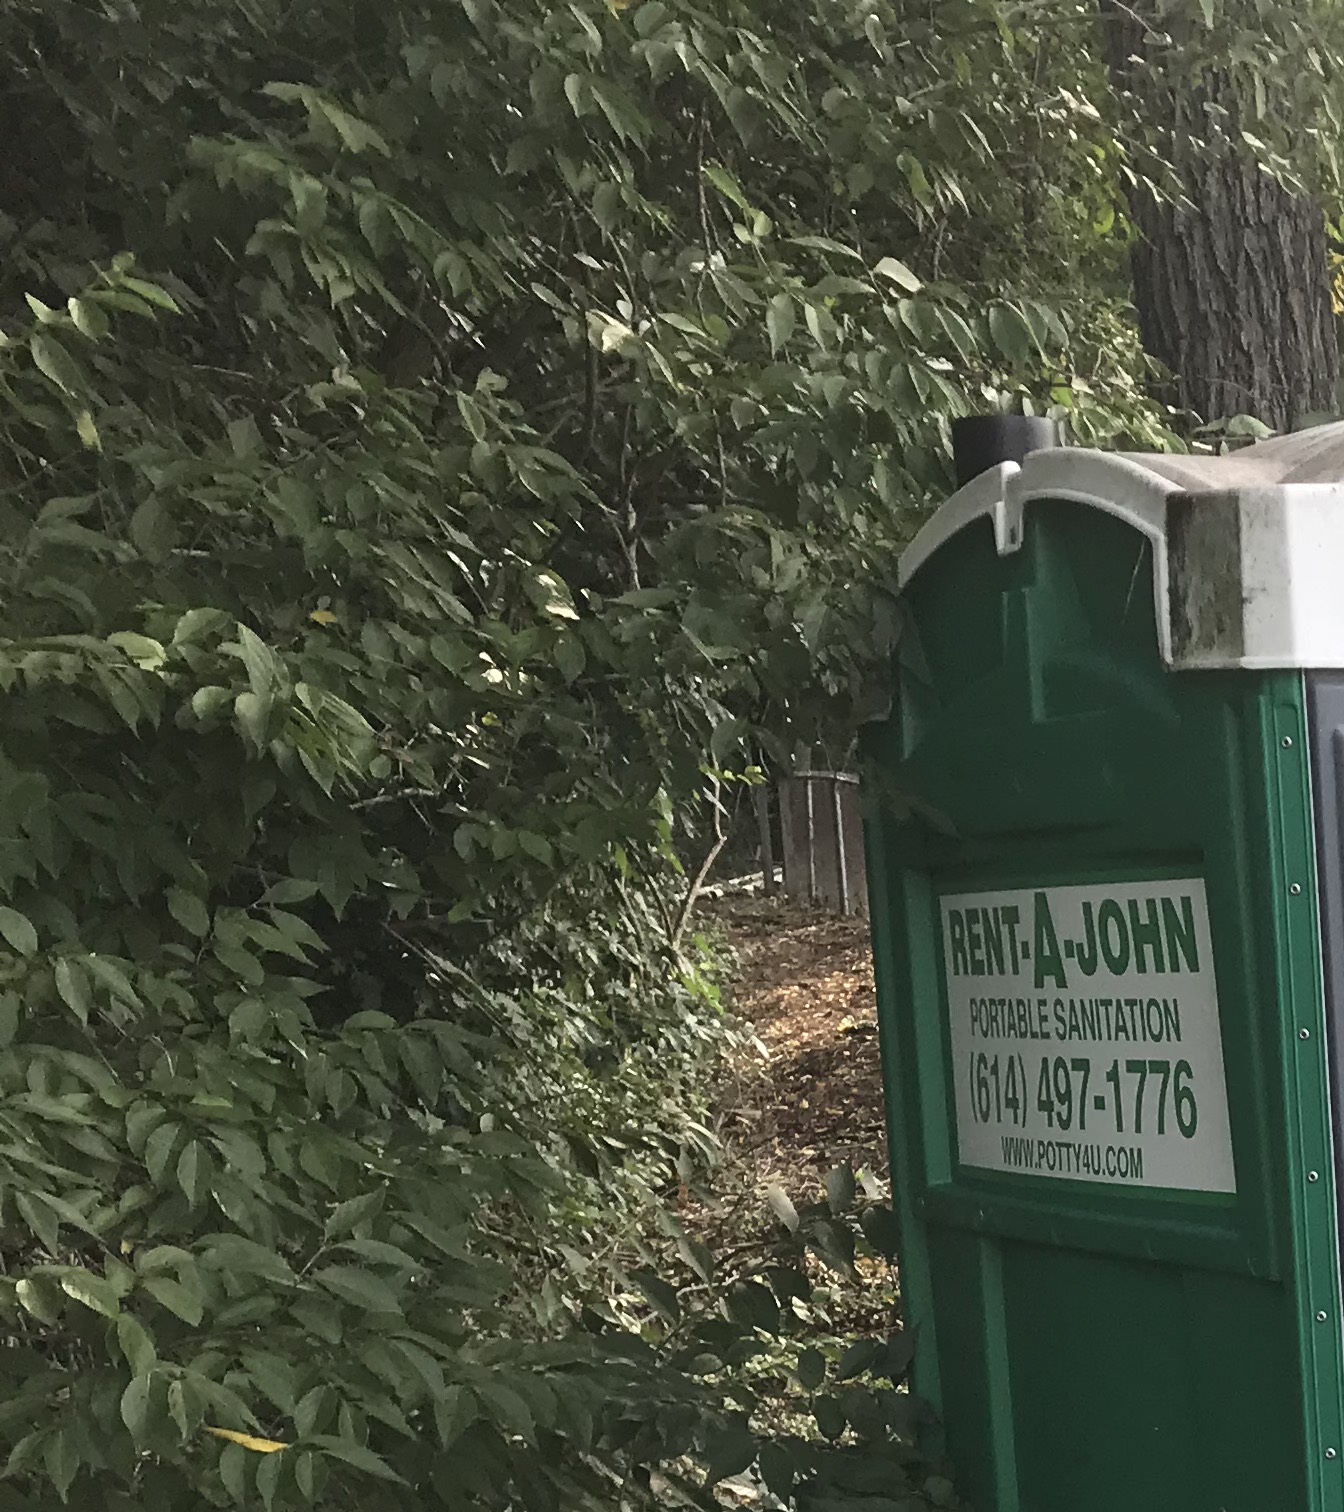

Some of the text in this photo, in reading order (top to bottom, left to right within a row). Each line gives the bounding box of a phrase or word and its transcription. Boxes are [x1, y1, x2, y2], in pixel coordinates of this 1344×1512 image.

[948, 892, 1200, 989] RENT-A-JOHN
[969, 997, 1182, 1042] PORTABLE SANITATION
[970, 1052, 1198, 1139] (614) 497-1776
[1001, 1136, 1144, 1179] WWW.POTTY4U.COM
